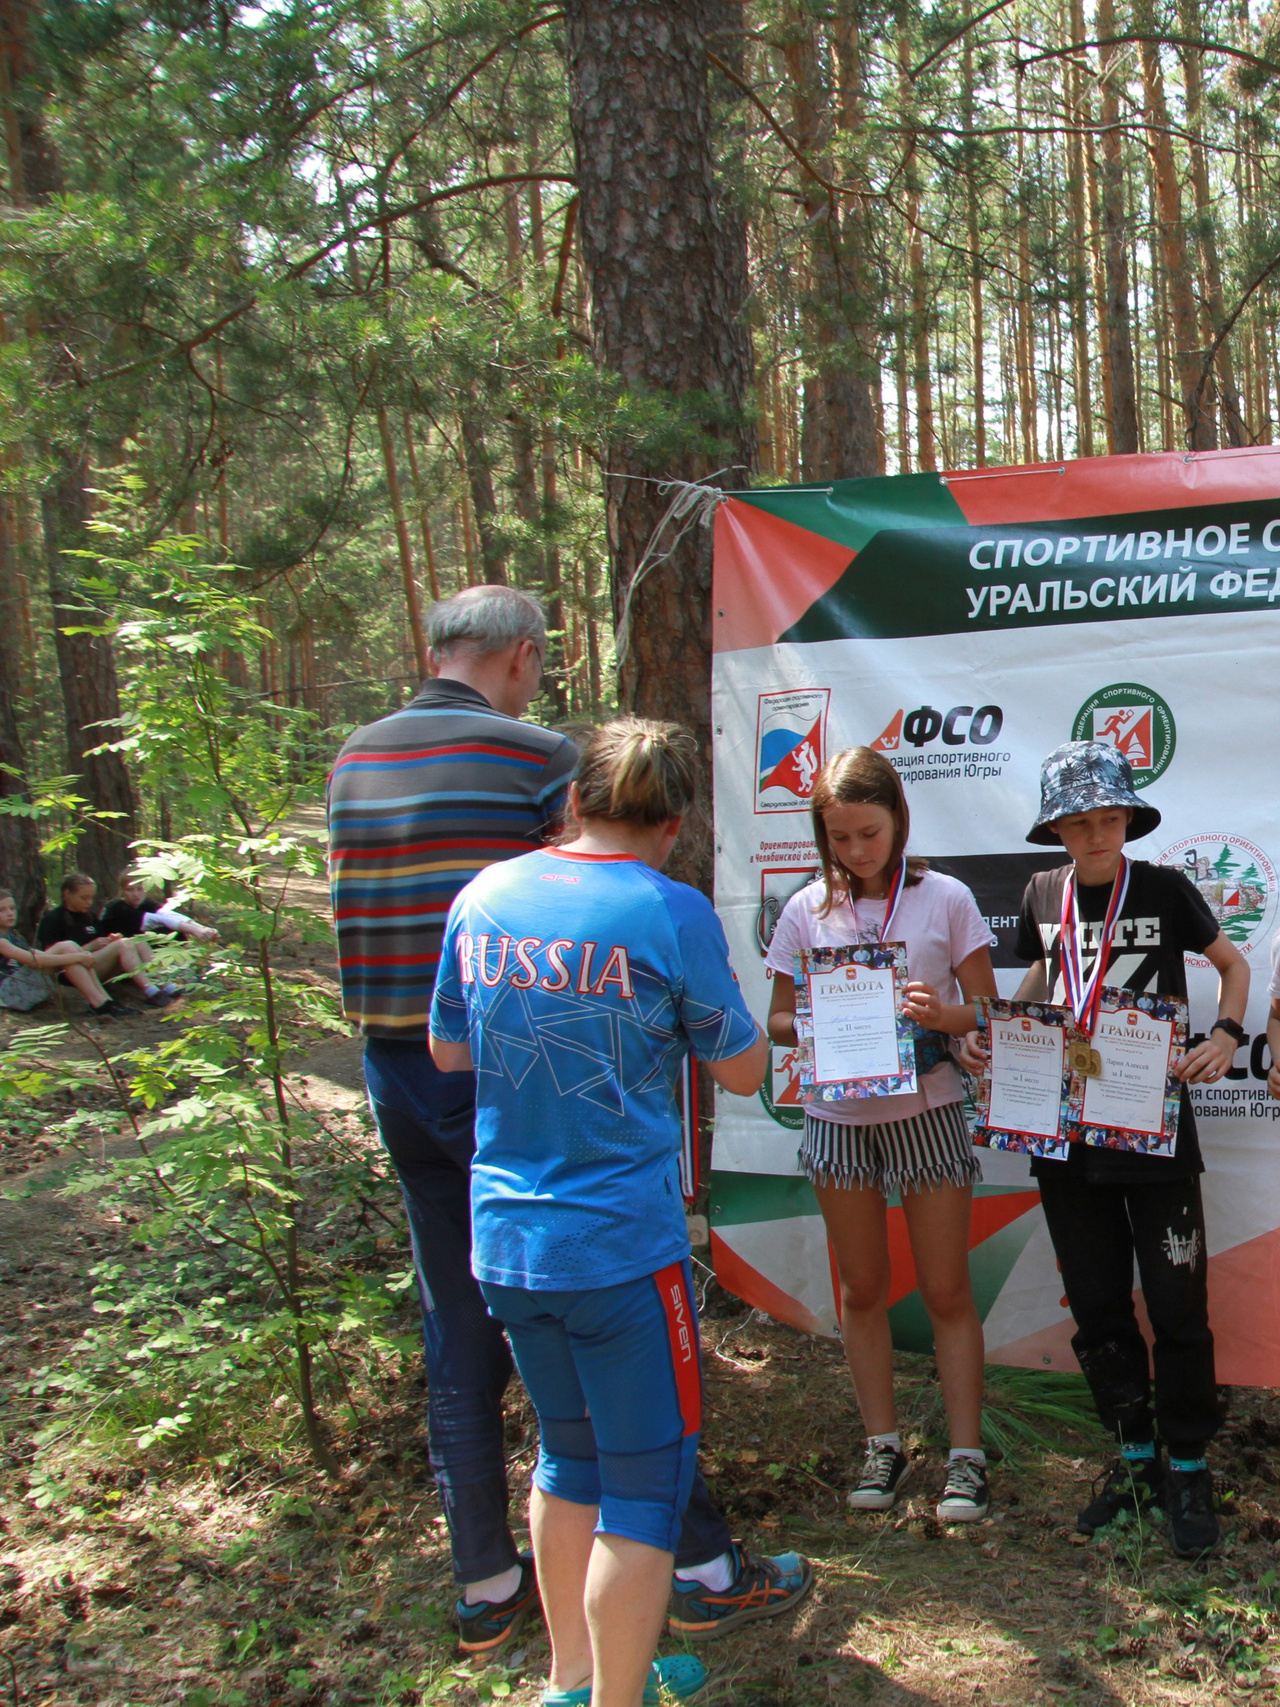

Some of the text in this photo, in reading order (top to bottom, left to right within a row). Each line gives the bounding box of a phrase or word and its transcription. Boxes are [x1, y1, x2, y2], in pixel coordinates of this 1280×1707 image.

[968, 522, 1251, 571] СПОРТИВНОЕ
[965, 566, 1198, 619] УРАЛЬСКИЙ
[903, 705, 1004, 748] ФСО
[1102, 687, 1156, 704] СПОРТИВНОГО
[1152, 705, 1172, 775] ОРИЕНТИРОВАНИЯ
[889, 752, 1011, 769] рация спортивного
[898, 763, 1002, 785] тирования Югры
[1168, 834, 1276, 893] СПОРТИВНОГО ОРИЕНТИРОВАНИЯ
[457, 933, 636, 1000] RUSSIA
[820, 981, 884, 995] ГРАМОТА
[999, 1030, 1056, 1047] ГРАМОТА
[1100, 1023, 1162, 1042] ГРАМОТА
[1205, 1088, 1274, 1104] спортивн
